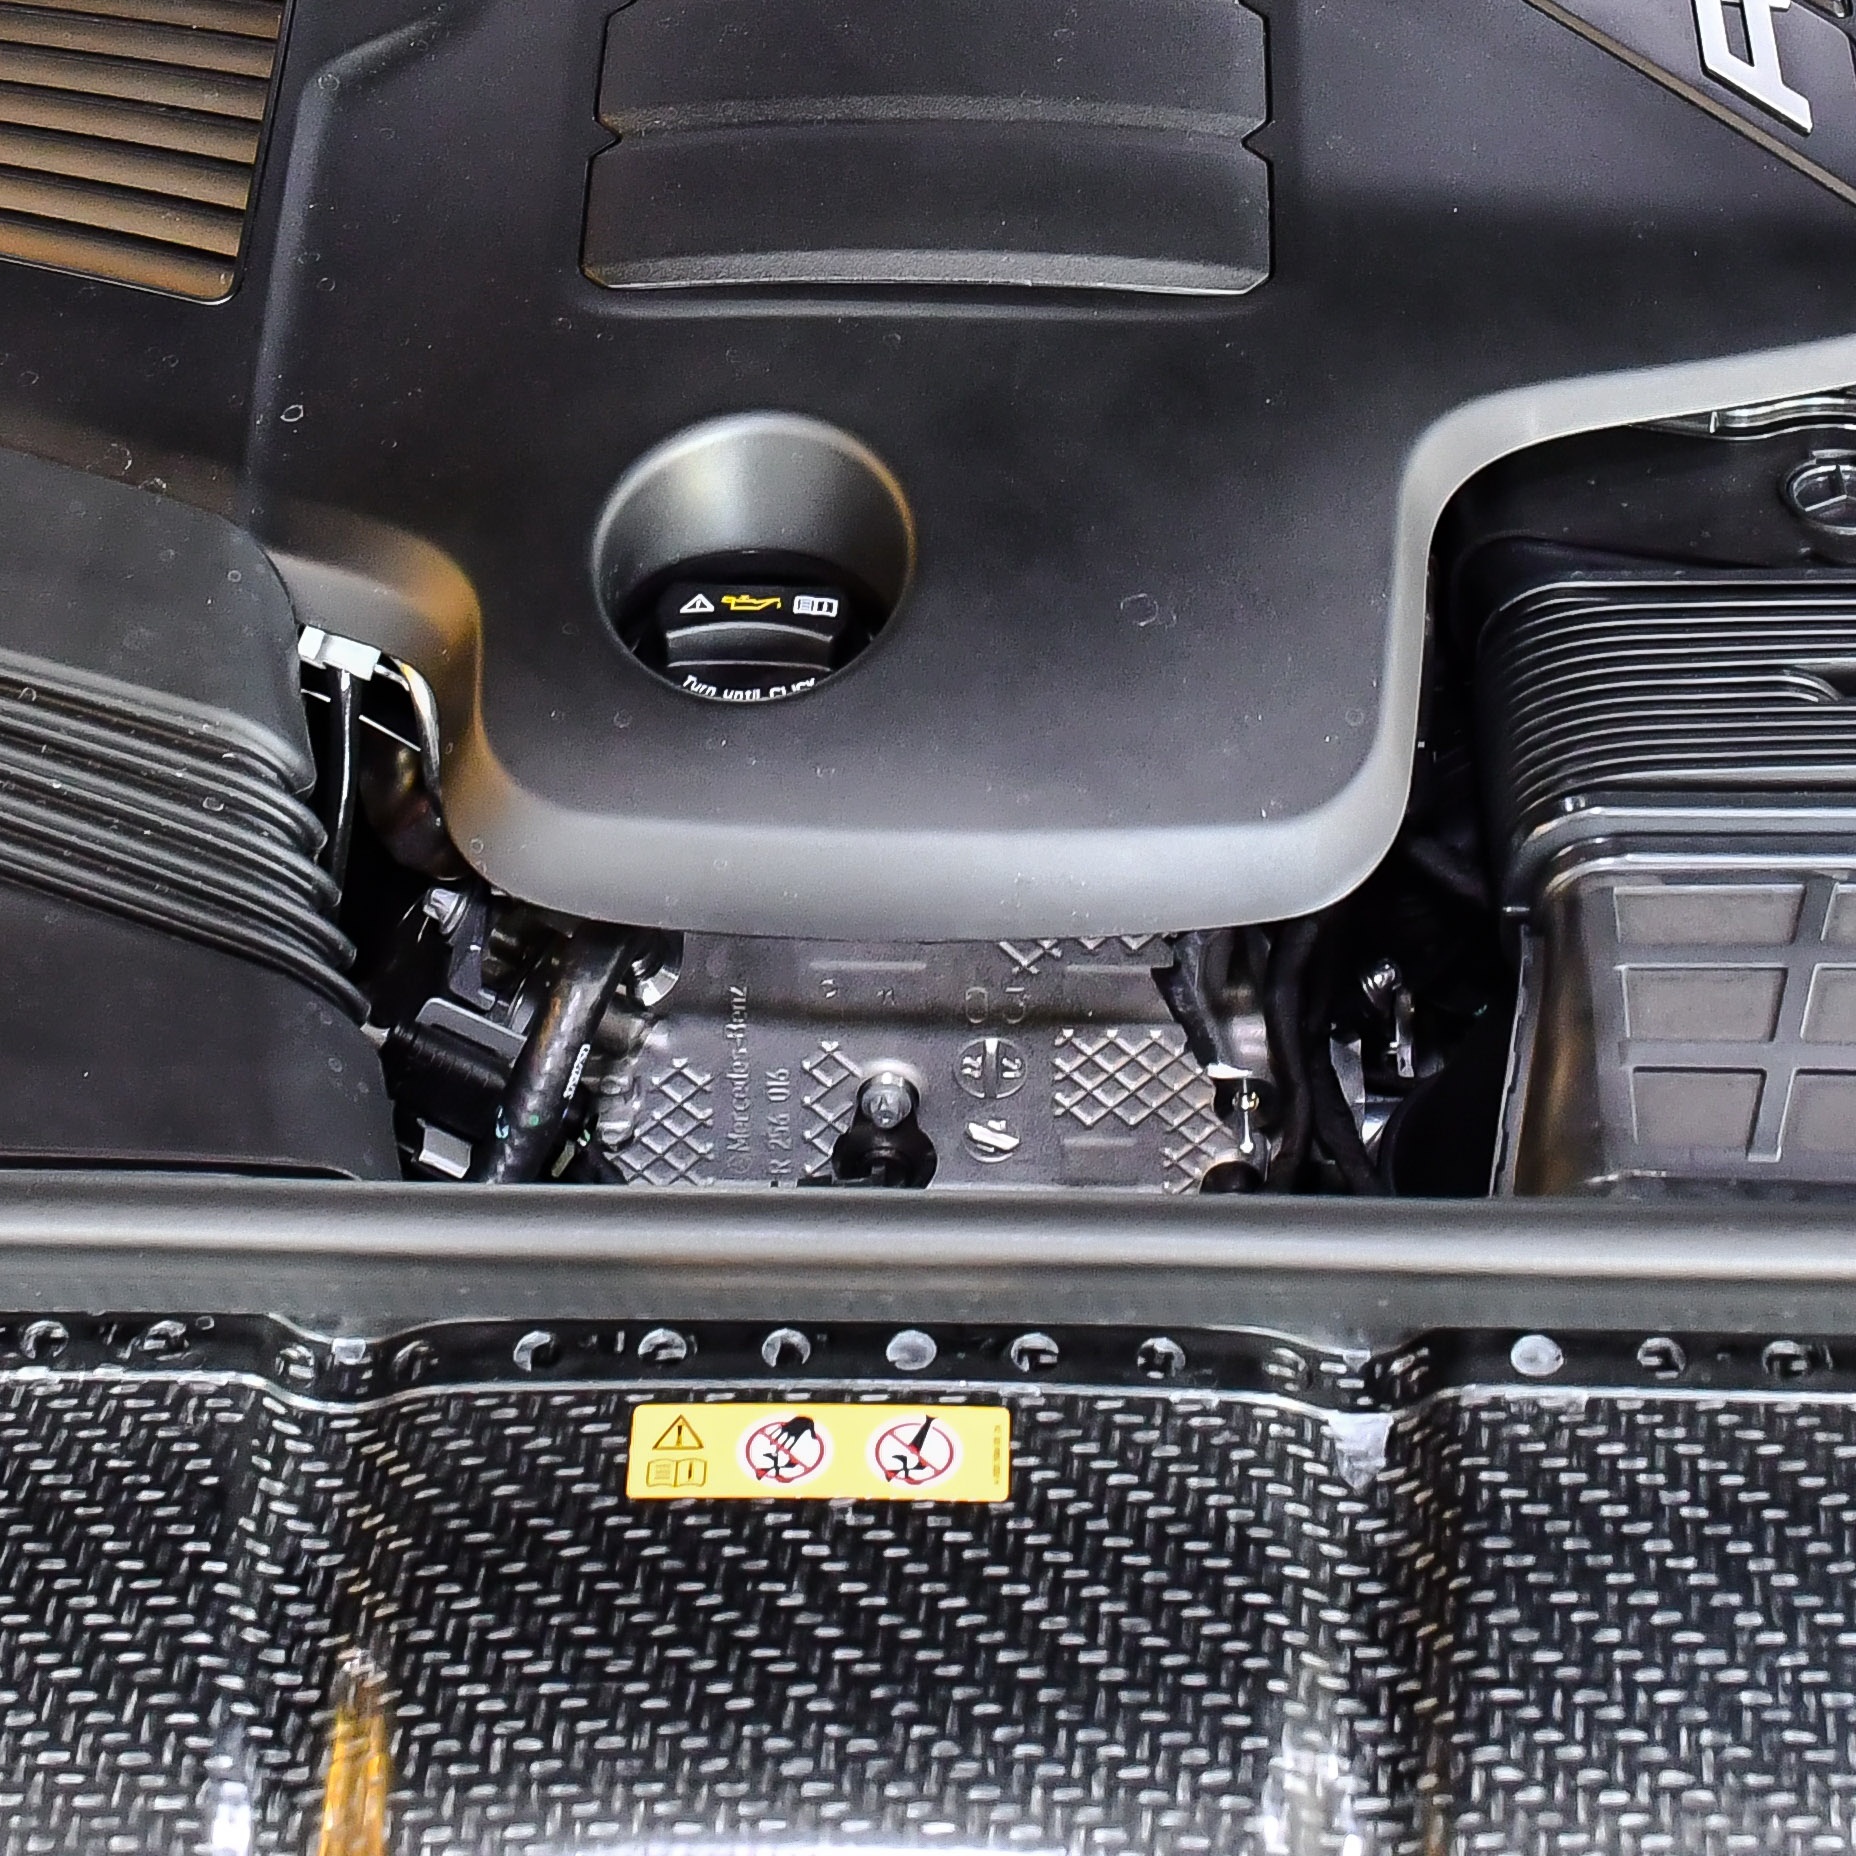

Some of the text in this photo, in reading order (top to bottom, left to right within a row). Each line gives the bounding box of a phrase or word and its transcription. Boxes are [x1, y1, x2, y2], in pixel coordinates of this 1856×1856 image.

[682, 674, 717, 698] Turn
[726, 986, 748, 1153] Mercedes-Benz
[770, 1157, 791, 1175] R
